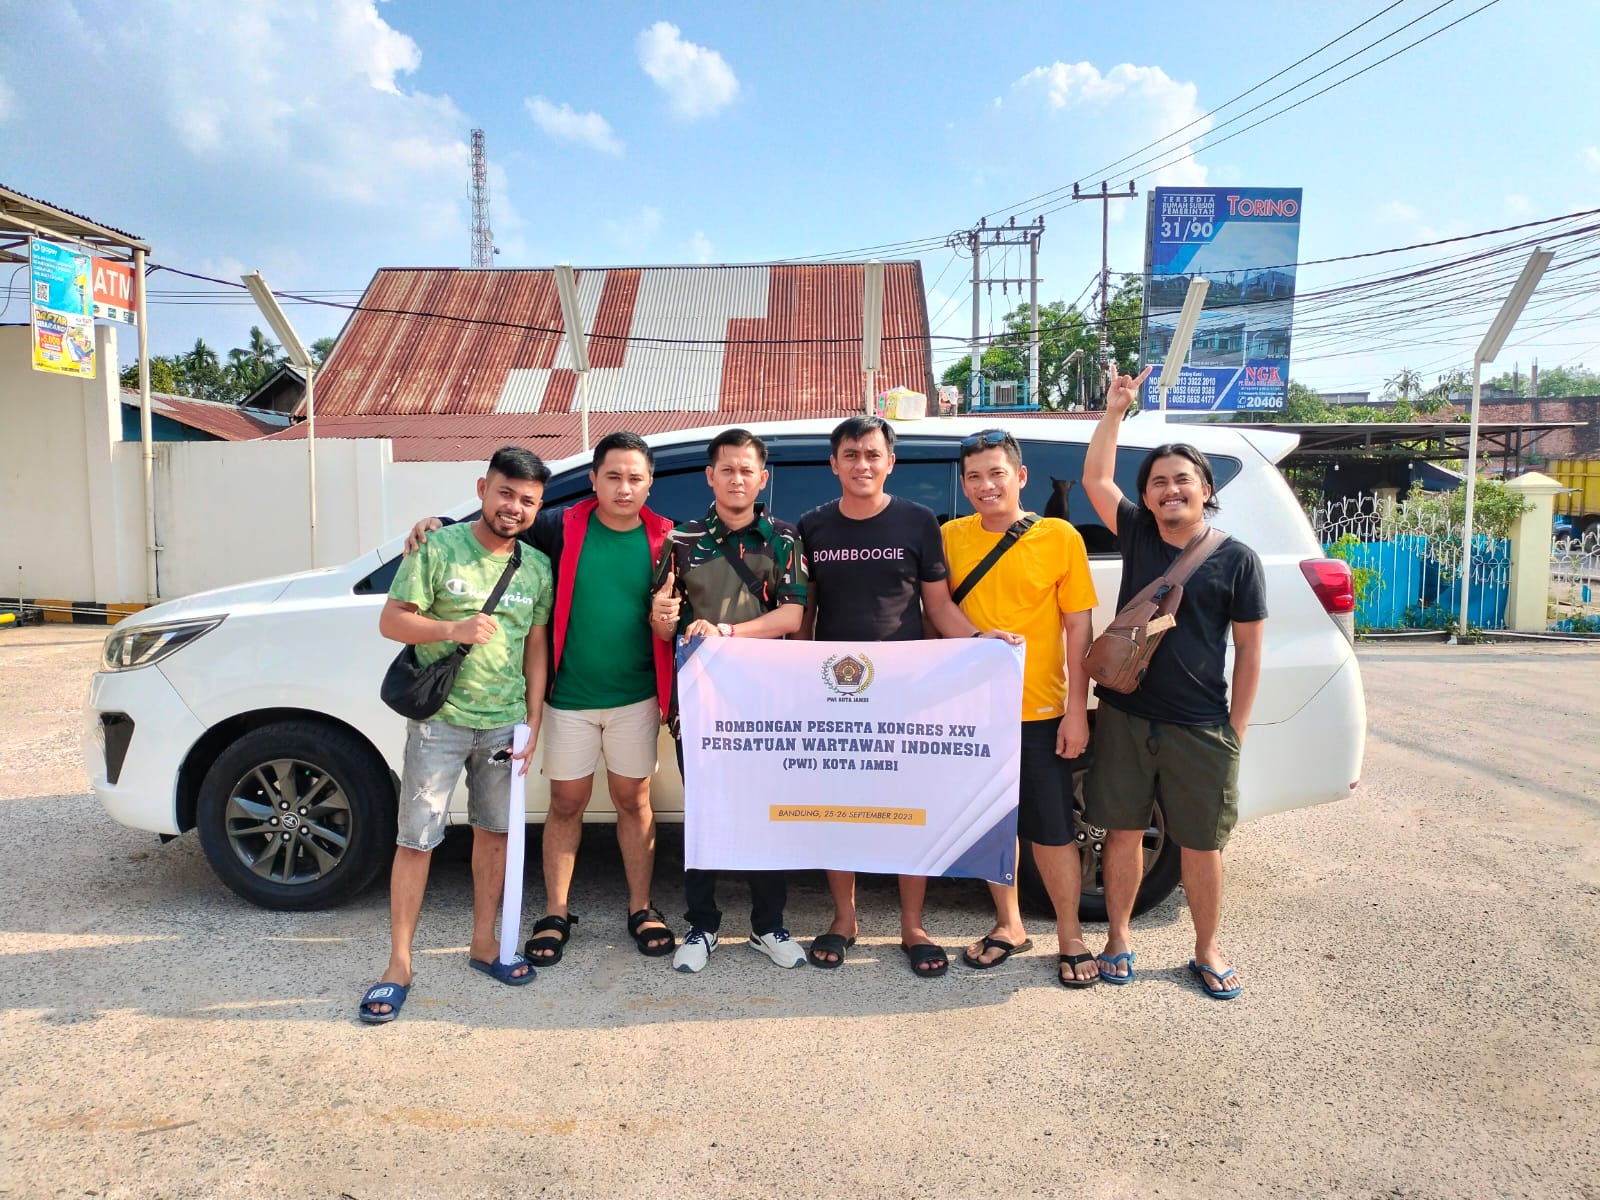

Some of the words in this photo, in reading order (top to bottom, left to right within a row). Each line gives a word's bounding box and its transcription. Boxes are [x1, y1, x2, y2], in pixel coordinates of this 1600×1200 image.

[1226, 195, 1299, 217] TORINO
[1161, 221, 1213, 241] 31/90
[94, 266, 134, 302] ATM
[1245, 366, 1281, 381] NGK
[1246, 396, 1283, 408] 20406
[813, 547, 905, 563] BOMBBOOGIE
[715, 720, 802, 733] ROMBONGAN
[807, 720, 873, 734] PESERTA
[877, 721, 944, 737] KONGRES
[948, 724, 977, 738] XXV
[701, 736, 797, 751] PERSATUAN
[802, 737, 895, 753] WARTAWAN
[901, 739, 991, 758] INDONESIA
[782, 757, 818, 771] (PWI)
[822, 758, 857, 770] KOTA
[860, 759, 899, 772] JAMBI
[778, 809, 822, 818] BANDUNG,
[823, 810, 847, 818] 25-26
[848, 811, 891, 820] SEPTEMBER
[892, 812, 913, 821] 2023
